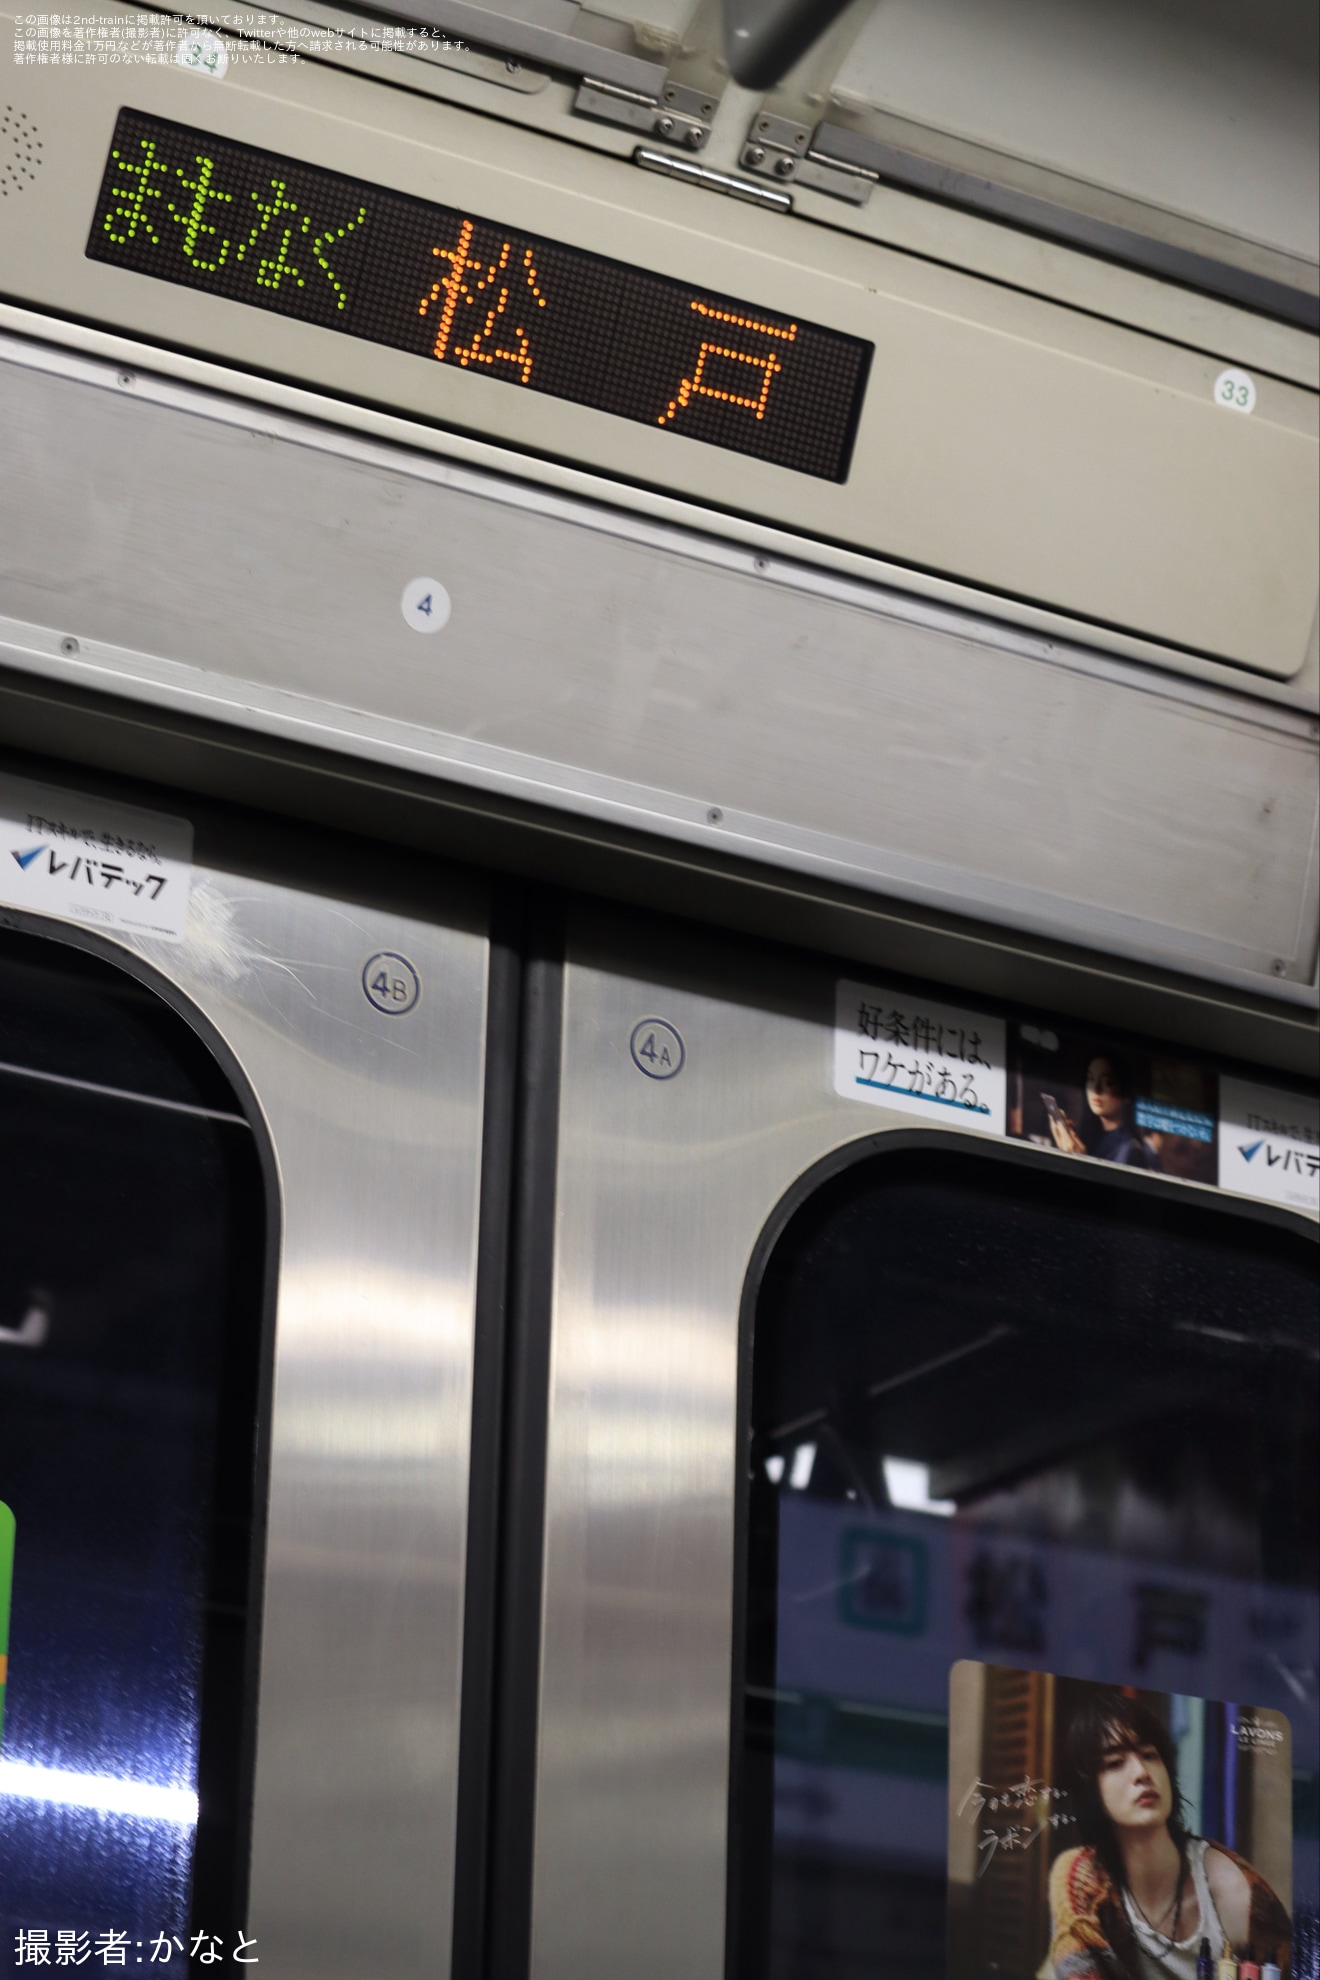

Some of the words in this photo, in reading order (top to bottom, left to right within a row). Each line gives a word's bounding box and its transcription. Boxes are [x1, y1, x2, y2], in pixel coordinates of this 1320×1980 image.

[103, 140, 366, 310] まもなく
[1221, 380, 1249, 407] 33
[417, 592, 433, 617] 4
[48, 848, 168, 901] レバテック
[370, 970, 408, 1003] 4B
[638, 1032, 673, 1068] 4A
[857, 1002, 992, 1071] 好条件には、
[859, 1050, 990, 1114] ワケがある。
[1229, 1723, 1284, 1743] LAVONS
